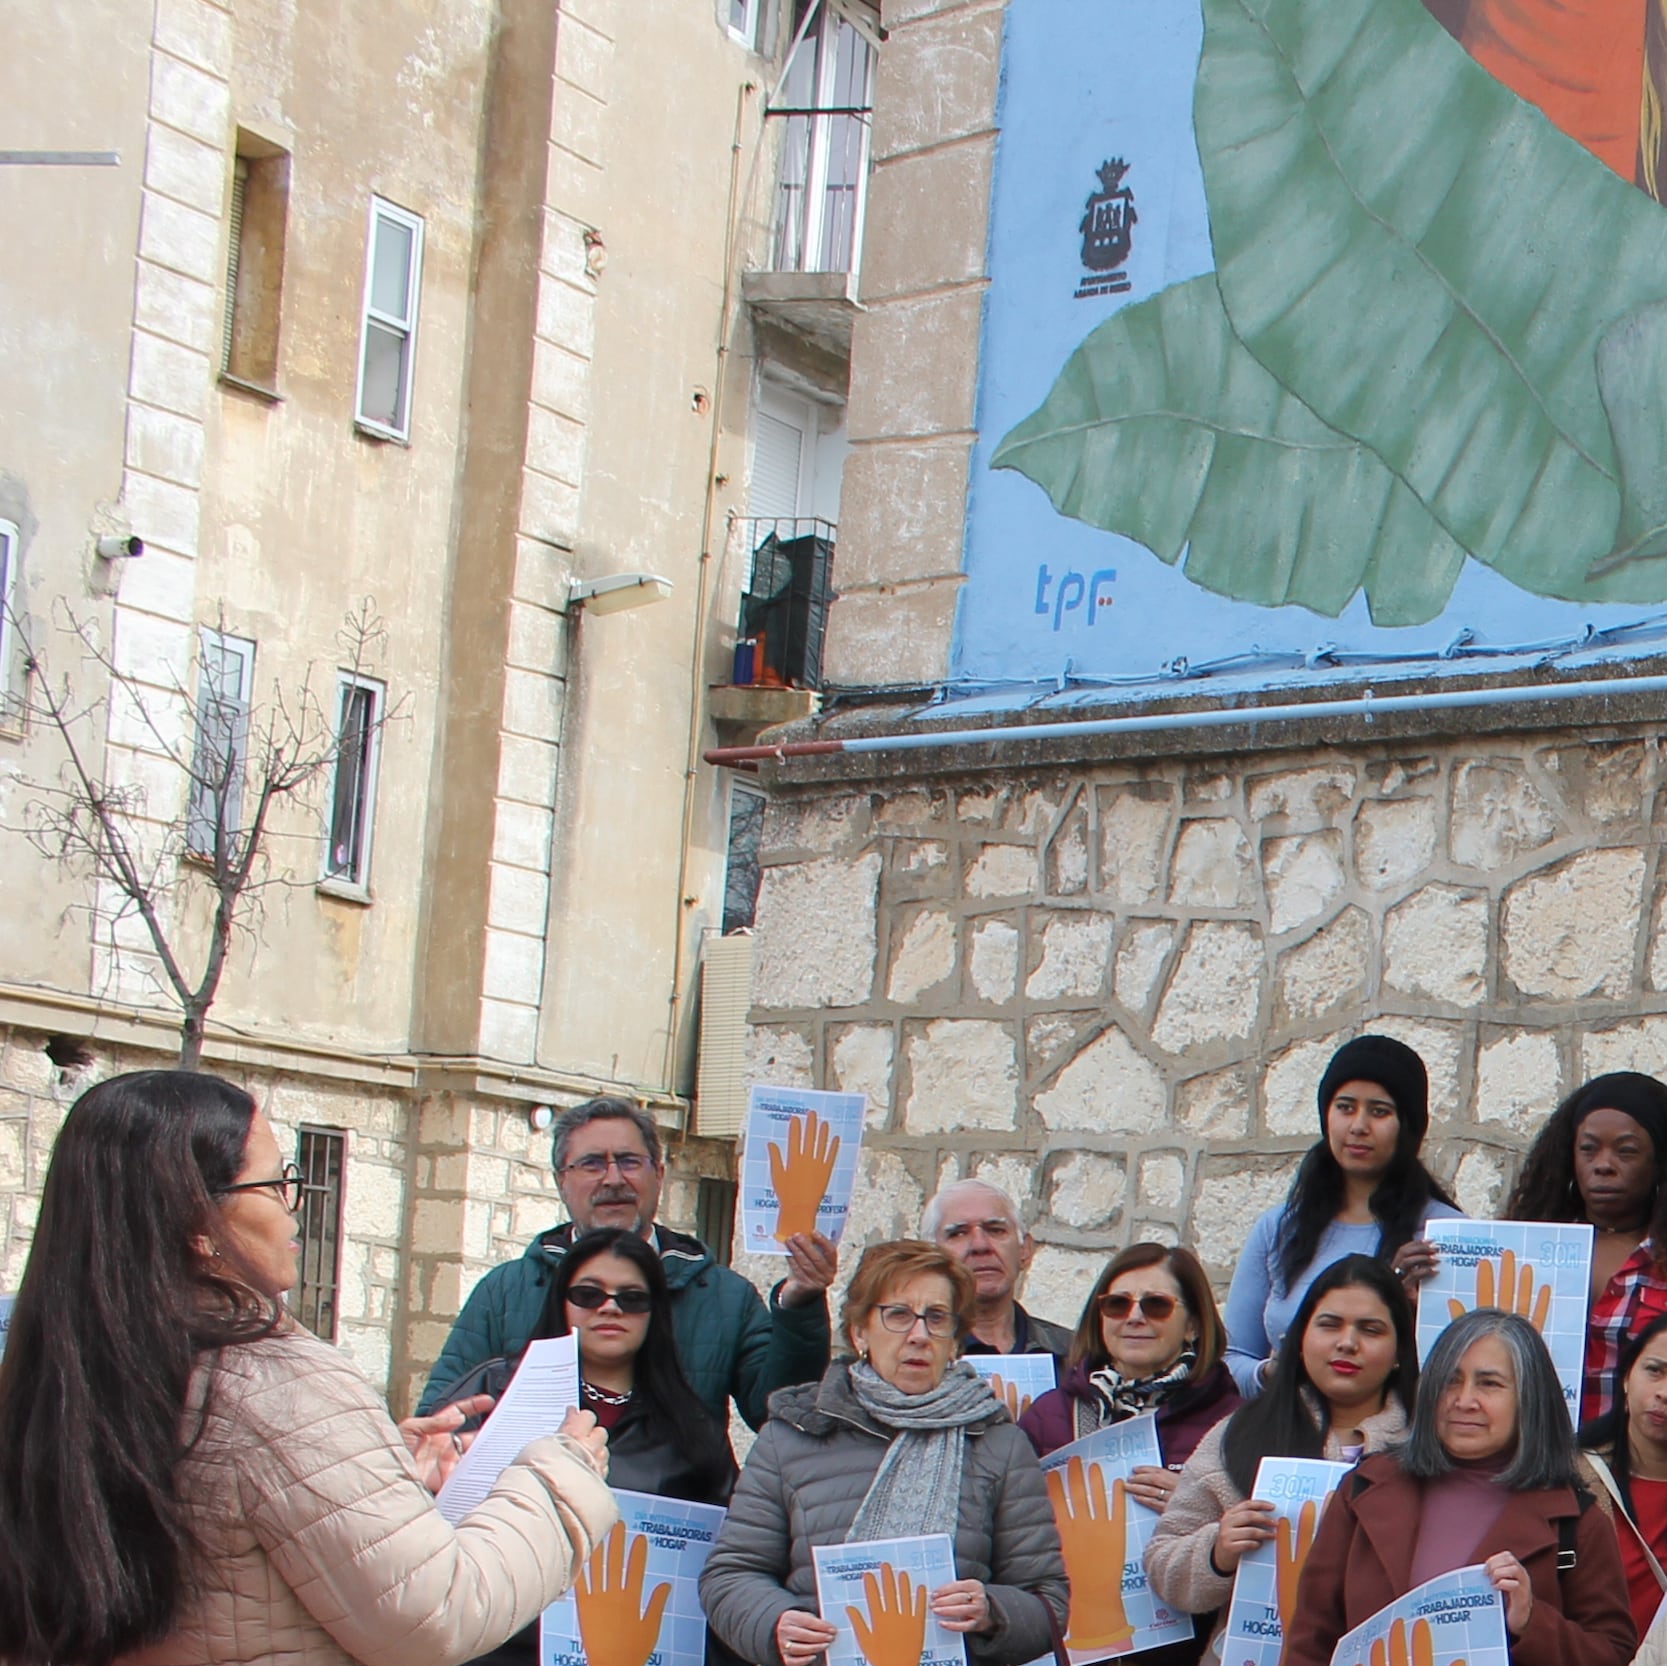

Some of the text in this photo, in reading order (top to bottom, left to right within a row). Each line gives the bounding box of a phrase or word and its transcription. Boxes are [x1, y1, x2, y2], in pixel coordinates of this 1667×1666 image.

[1436, 1242, 1505, 1258] TRABAJADORAS
[1539, 1241, 1582, 1268] 30M
[1105, 1431, 1149, 1463] 30M
[1269, 1473, 1316, 1500] 30M
[641, 1521, 713, 1542] TRABAJADORAS
[655, 1537, 687, 1551] HOGAR
[1123, 1563, 1139, 1577] SU
[1418, 1594, 1495, 1616] TRABAJADORAS
[1264, 1607, 1279, 1621] TU
[1436, 1610, 1471, 1625] HOGAR
[1242, 1620, 1283, 1638] HOGAR
[570, 1640, 584, 1653] TU
[647, 1653, 662, 1666] SU
[856, 1657, 867, 1666] TU
[921, 1650, 934, 1660] SU
